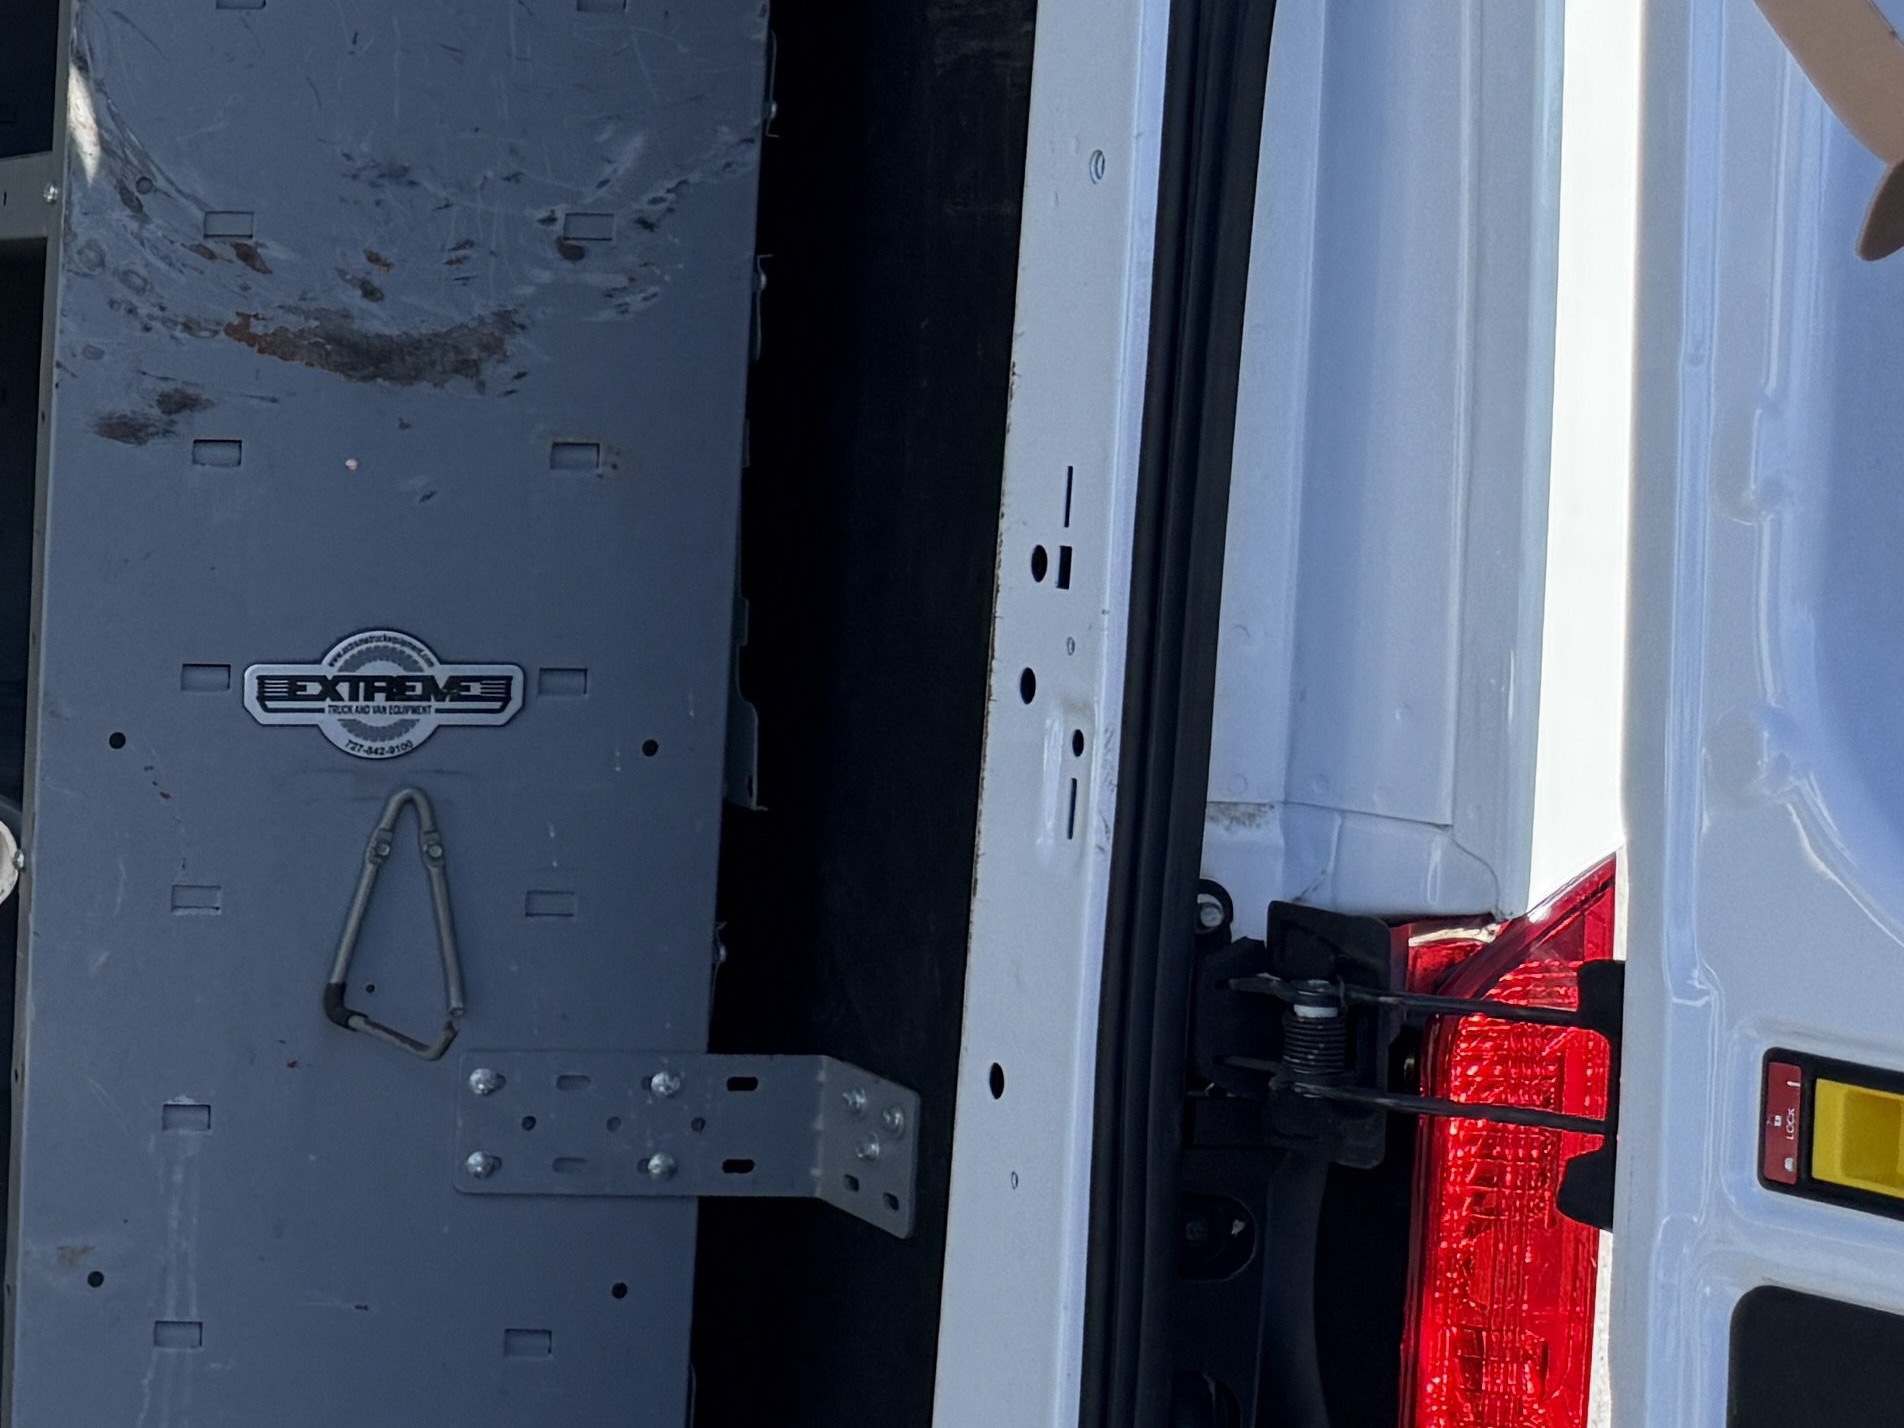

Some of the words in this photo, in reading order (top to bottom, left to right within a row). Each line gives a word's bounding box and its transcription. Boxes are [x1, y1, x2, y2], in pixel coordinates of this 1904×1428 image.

[257, 675, 513, 702] EXTREME
[327, 705, 354, 715] TRUCK
[355, 705, 370, 715] AND
[372, 705, 387, 715] VAN
[389, 705, 432, 715] EQUIPMENT
[345, 739, 413, 756] 727-842-9100
[1786, 1107, 1795, 1140] LOCK
